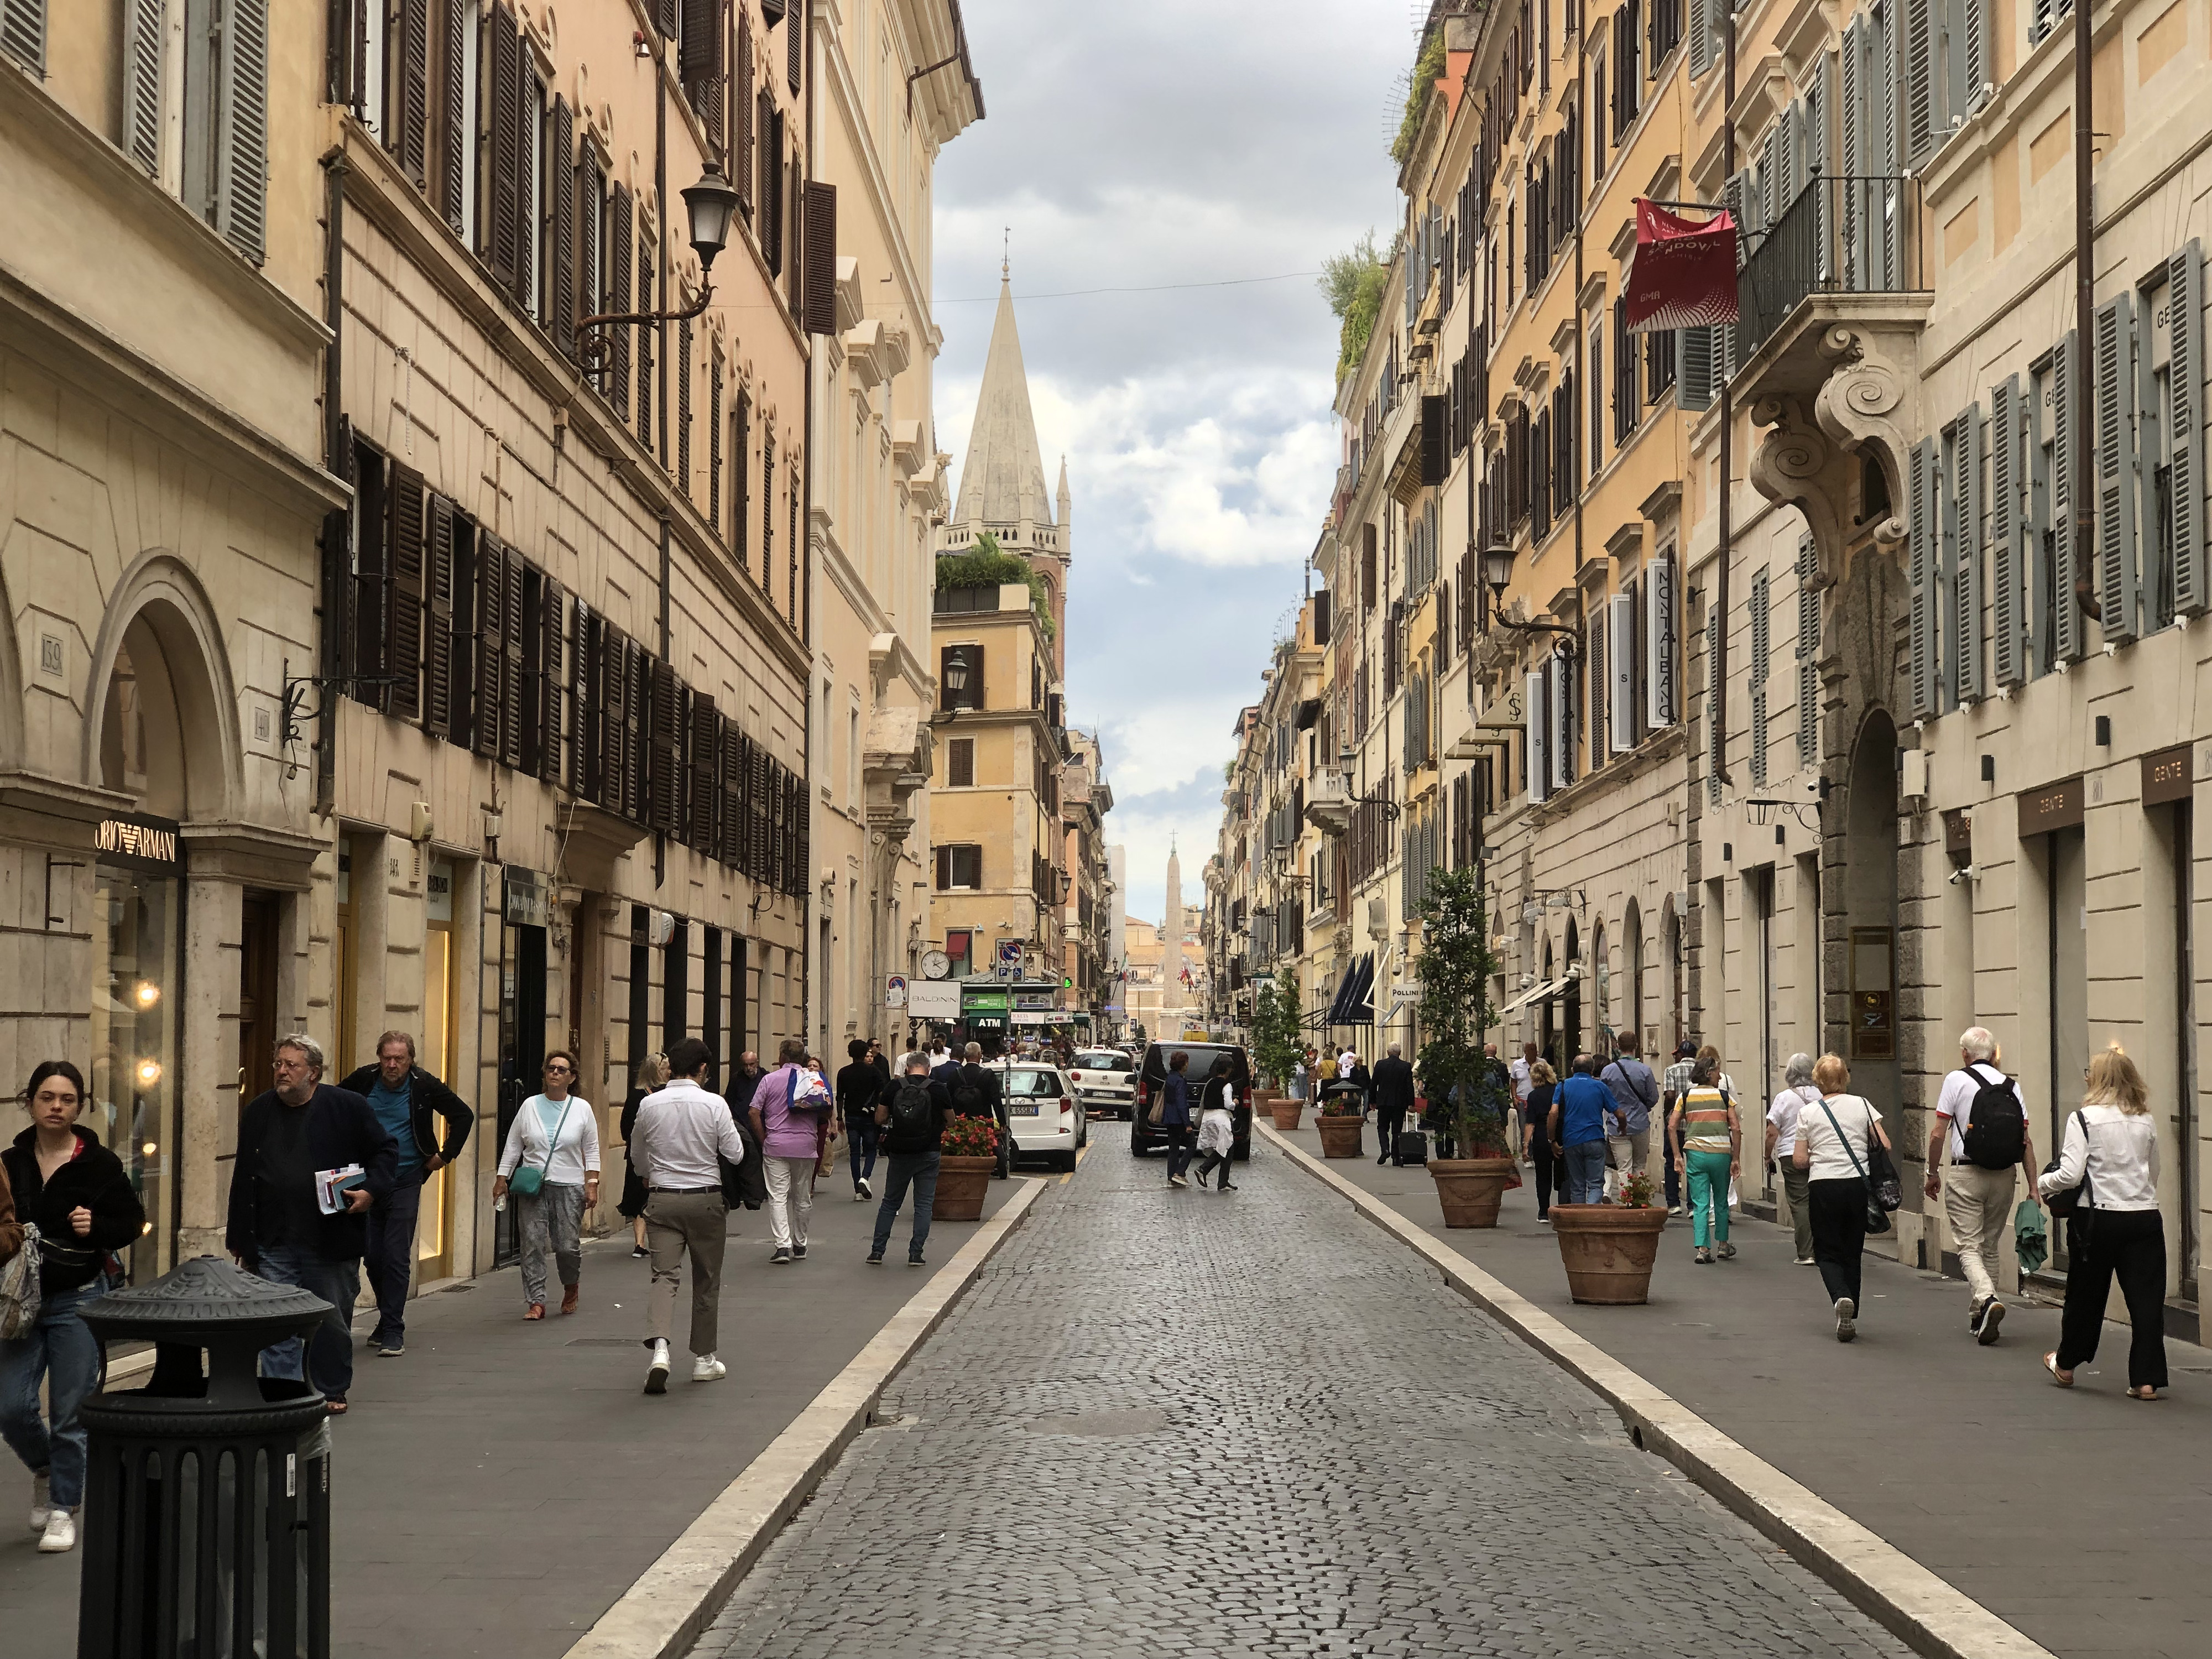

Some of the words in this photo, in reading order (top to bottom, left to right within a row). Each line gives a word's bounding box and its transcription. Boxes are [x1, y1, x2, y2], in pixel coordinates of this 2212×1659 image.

[1640, 290, 1660, 302] GMA
[42, 639, 61, 670] 139
[2154, 761, 2182, 782] GENTE
[2039, 794, 2064, 813] GENTE
[136, 827, 176, 862] ARMANI
[911, 995, 959, 1004] BALDININI
[978, 1018, 1001, 1027] ATM
